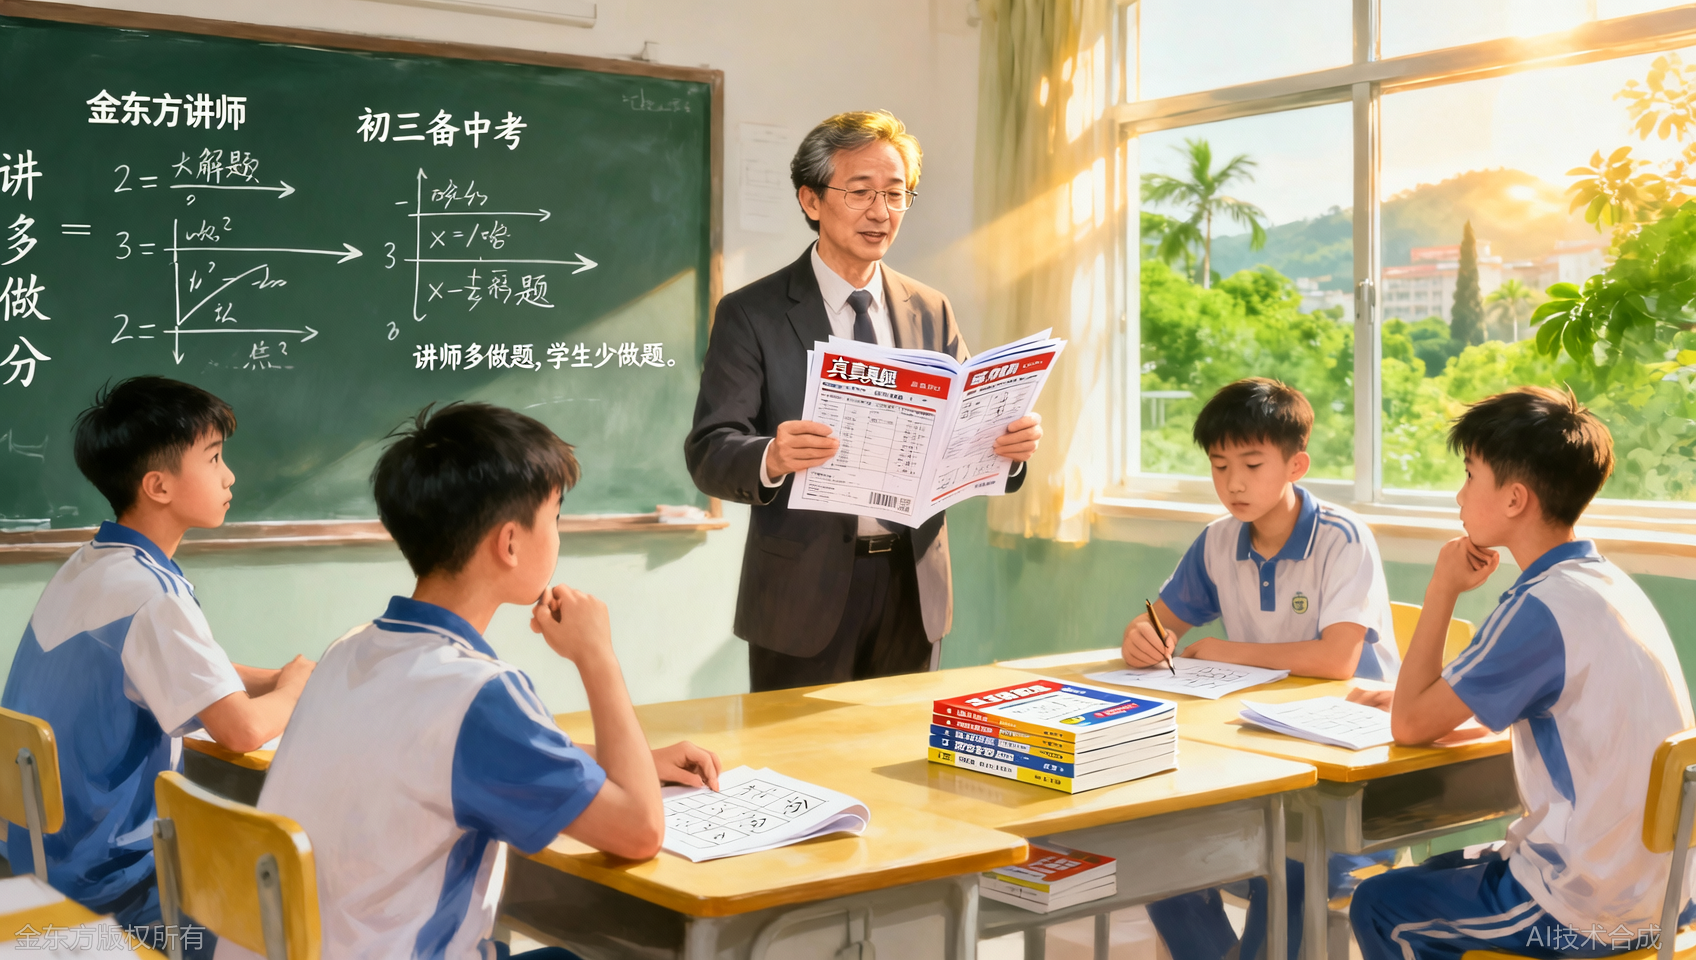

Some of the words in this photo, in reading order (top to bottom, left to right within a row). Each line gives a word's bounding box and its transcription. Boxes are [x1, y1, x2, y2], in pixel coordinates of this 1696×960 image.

[86, 88, 248, 131] 金东方讲师
[356, 106, 528, 151] 初三备中考
